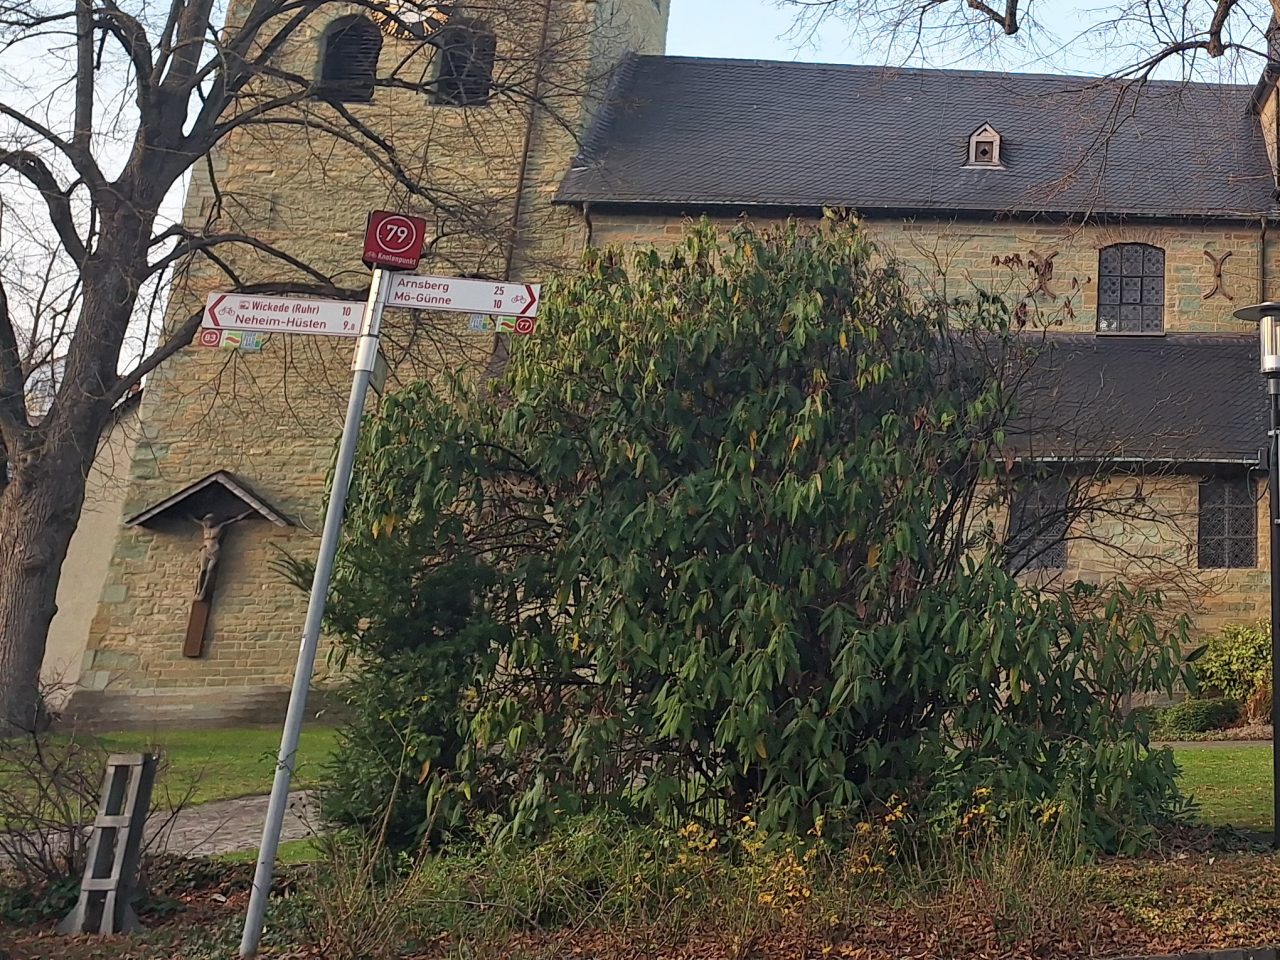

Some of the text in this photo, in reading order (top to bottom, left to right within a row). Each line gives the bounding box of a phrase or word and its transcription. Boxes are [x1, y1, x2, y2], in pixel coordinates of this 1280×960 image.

[386, 224, 408, 243] 79
[378, 252, 417, 265] Knotenpunkt
[397, 278, 505, 296] Arnsberg 25
[394, 291, 502, 309] Mö-Günne 10
[252, 301, 352, 317] Wickede (Ruhr) 10
[235, 314, 327, 330] Neheim-Hüsten
